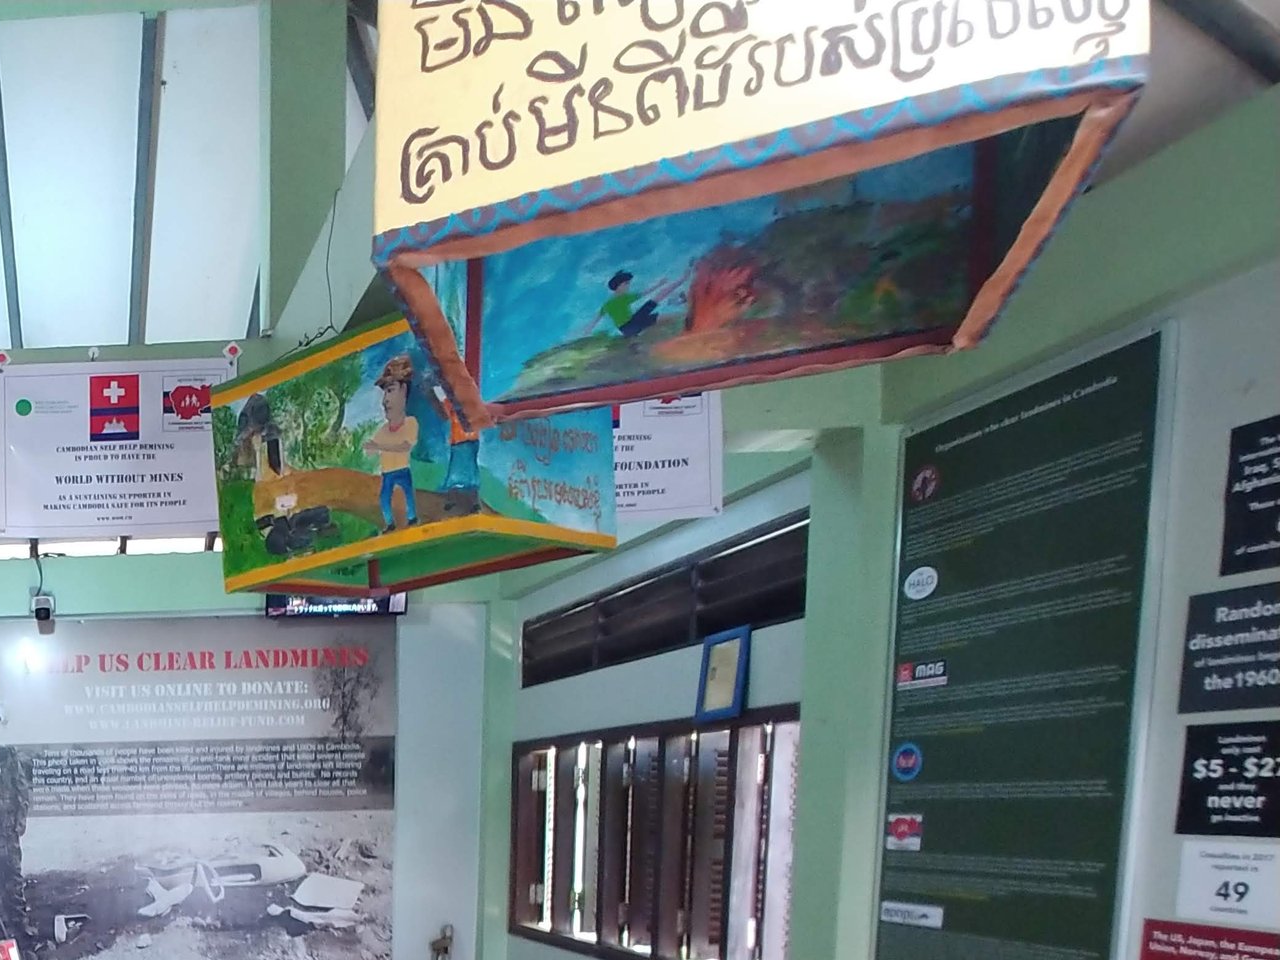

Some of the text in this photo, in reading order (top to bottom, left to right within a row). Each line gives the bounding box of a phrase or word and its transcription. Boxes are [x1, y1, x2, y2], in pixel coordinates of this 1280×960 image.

[56, 445, 98, 453] CAMBODIAN
[614, 457, 689, 471] FOUNDATION
[55, 472, 184, 485] WORLD WITHOUT MINES
[74, 493, 117, 501] SUSTAINING
[637, 488, 665, 496] PEOPLE
[72, 502, 109, 510] CAMBODIA
[111, 501, 129, 509] SAFE
[159, 499, 187, 507] PEOPLE
[98, 653, 129, 673] US
[137, 651, 215, 672] CLEAR
[224, 647, 369, 669] LANDMINES
[915, 661, 944, 679] MAG
[85, 680, 308, 698] VISIT US ONLINE TO DONATE:
[1203, 674, 1233, 691] the
[1192, 757, 1224, 779] $5
[1207, 794, 1266, 809] never
[1215, 881, 1249, 903] 49
[1152, 930, 1168, 941] The
[1220, 937, 1236, 949] the
